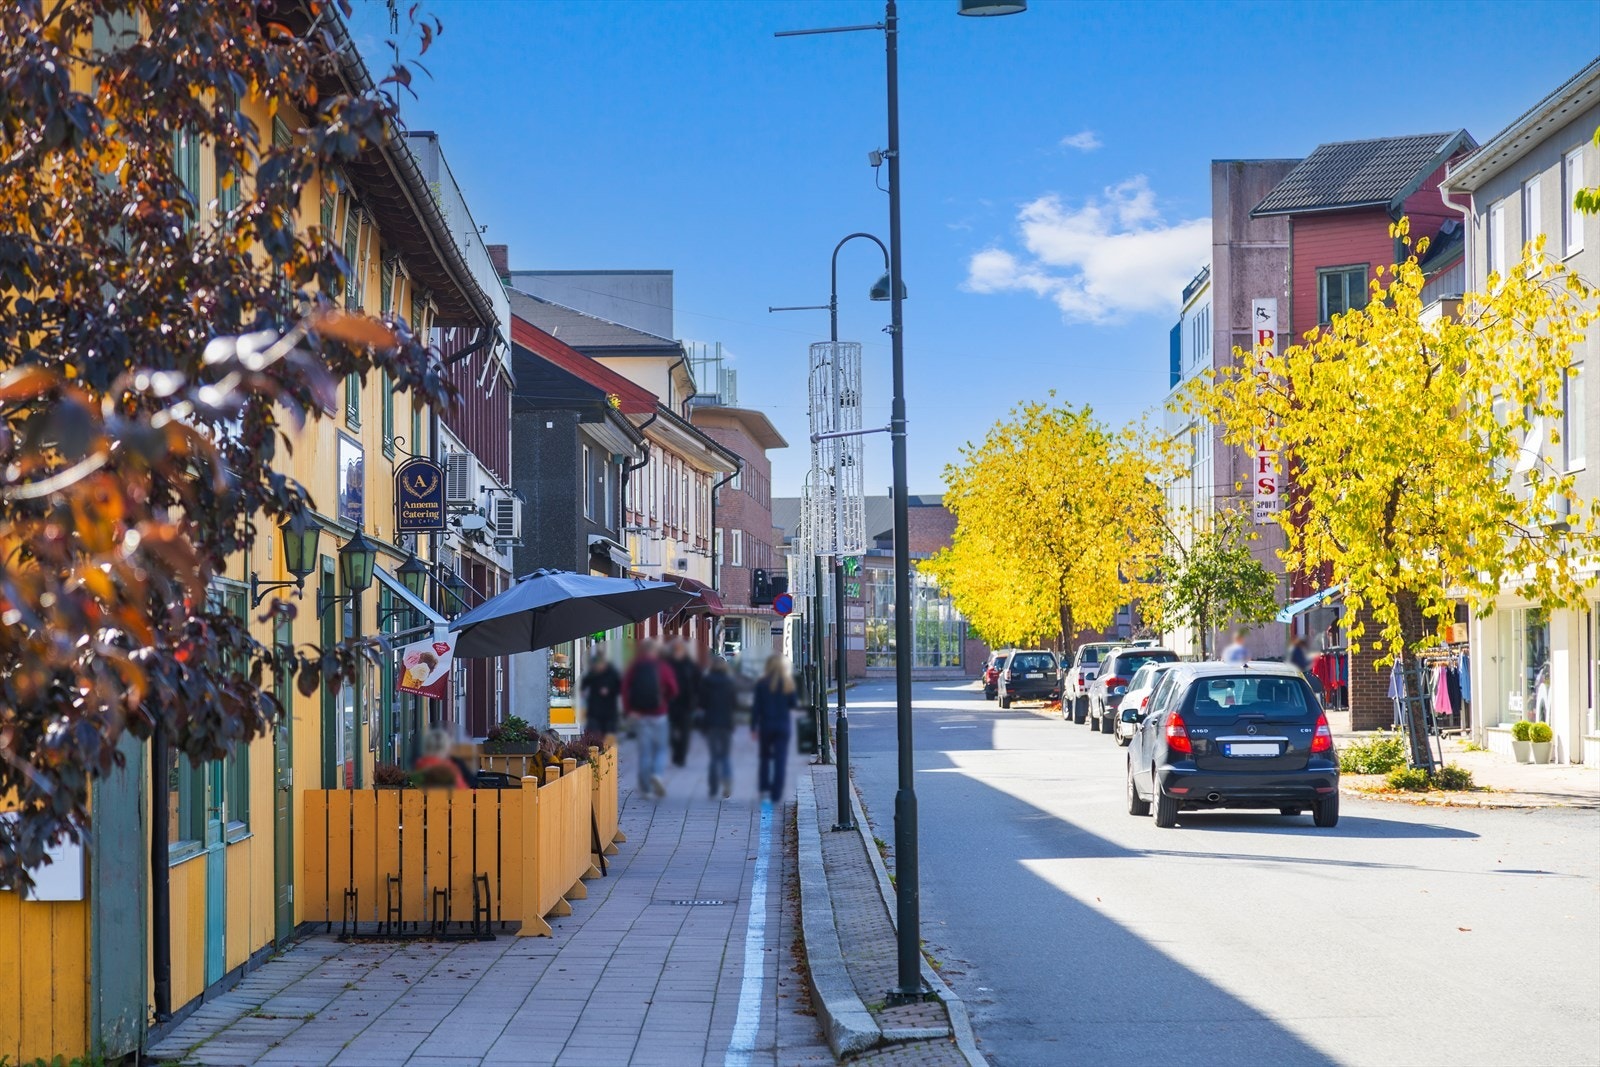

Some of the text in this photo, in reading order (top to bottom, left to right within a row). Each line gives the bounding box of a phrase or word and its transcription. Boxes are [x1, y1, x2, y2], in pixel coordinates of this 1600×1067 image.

[414, 475, 427, 488] A
[1256, 500, 1276, 508] SPORT
[402, 510, 440, 520] Catering
